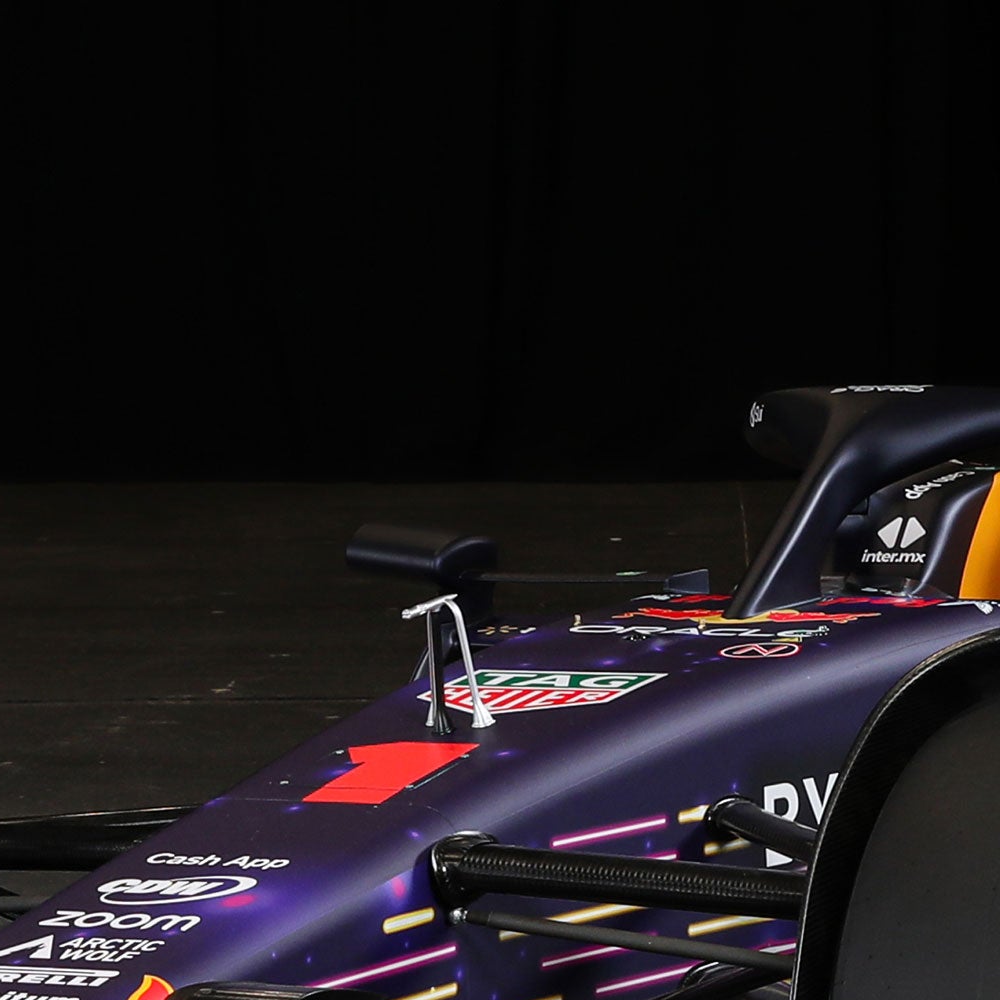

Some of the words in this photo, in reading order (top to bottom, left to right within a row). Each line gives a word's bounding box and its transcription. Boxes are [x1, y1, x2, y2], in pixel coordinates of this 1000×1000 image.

[861, 549, 926, 563] inter.mx
[482, 673, 638, 688] TAG
[302, 741, 480, 804] 1
[146, 852, 222, 866] Cash
[222, 854, 290, 870] App
[97, 878, 225, 896] CDW
[38, 910, 201, 932] zoom
[59, 937, 165, 951] ARCTIC
[59, 949, 141, 962] WOLF
